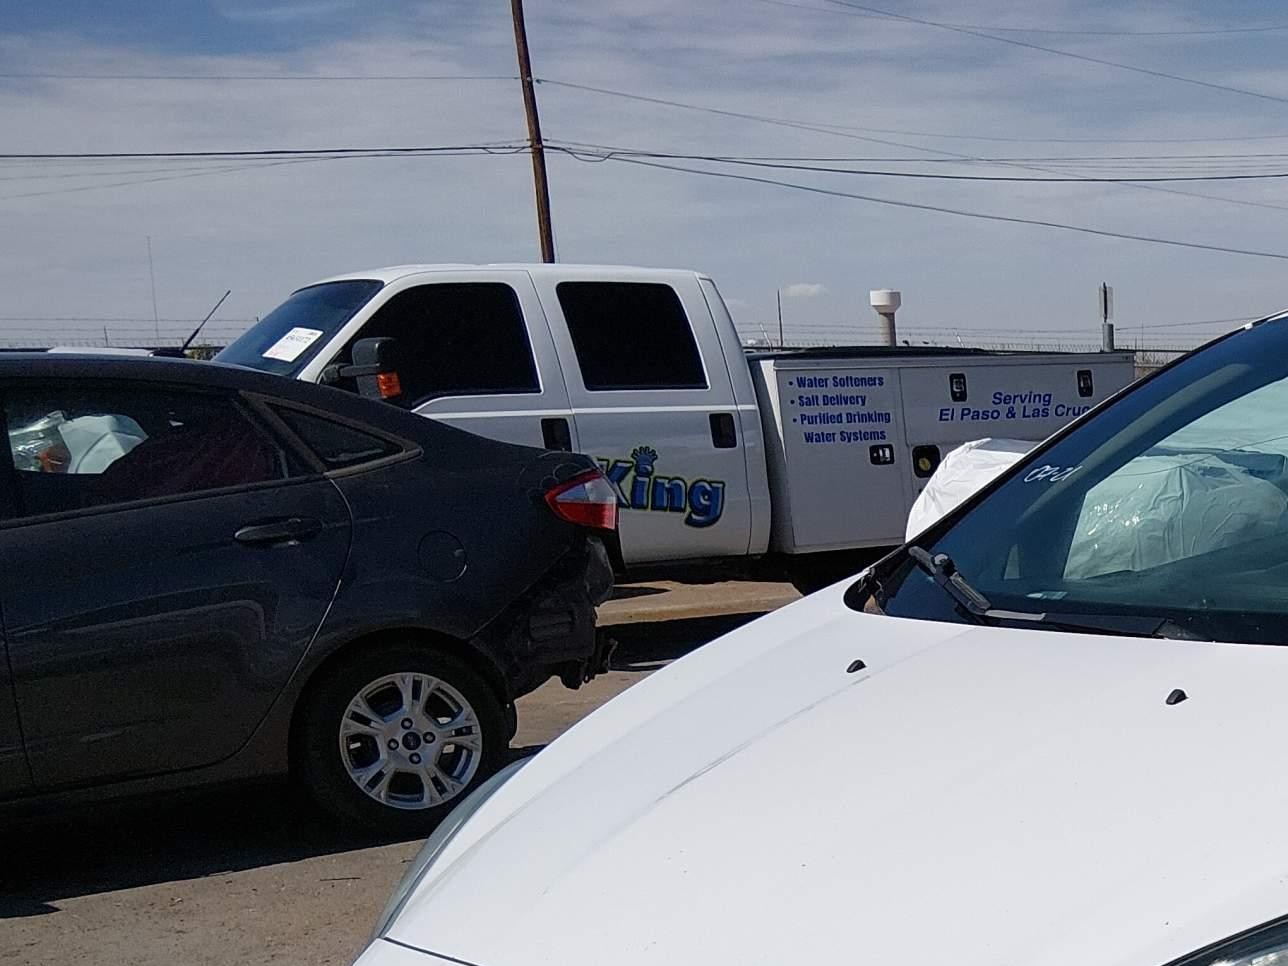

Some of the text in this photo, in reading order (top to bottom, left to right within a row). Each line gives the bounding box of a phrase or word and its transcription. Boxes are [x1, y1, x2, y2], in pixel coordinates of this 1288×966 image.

[796, 375, 884, 388] Water Softeners
[798, 393, 866, 407] Salt Delivery
[991, 390, 1052, 406] Serving
[800, 410, 891, 425] Purified Drinking
[939, 408, 955, 422] El
[960, 407, 1001, 421] Paso
[1005, 406, 1016, 419] &
[1022, 405, 1050, 419] Las
[804, 430, 887, 443] Water Systems
[597, 456, 725, 528] King
